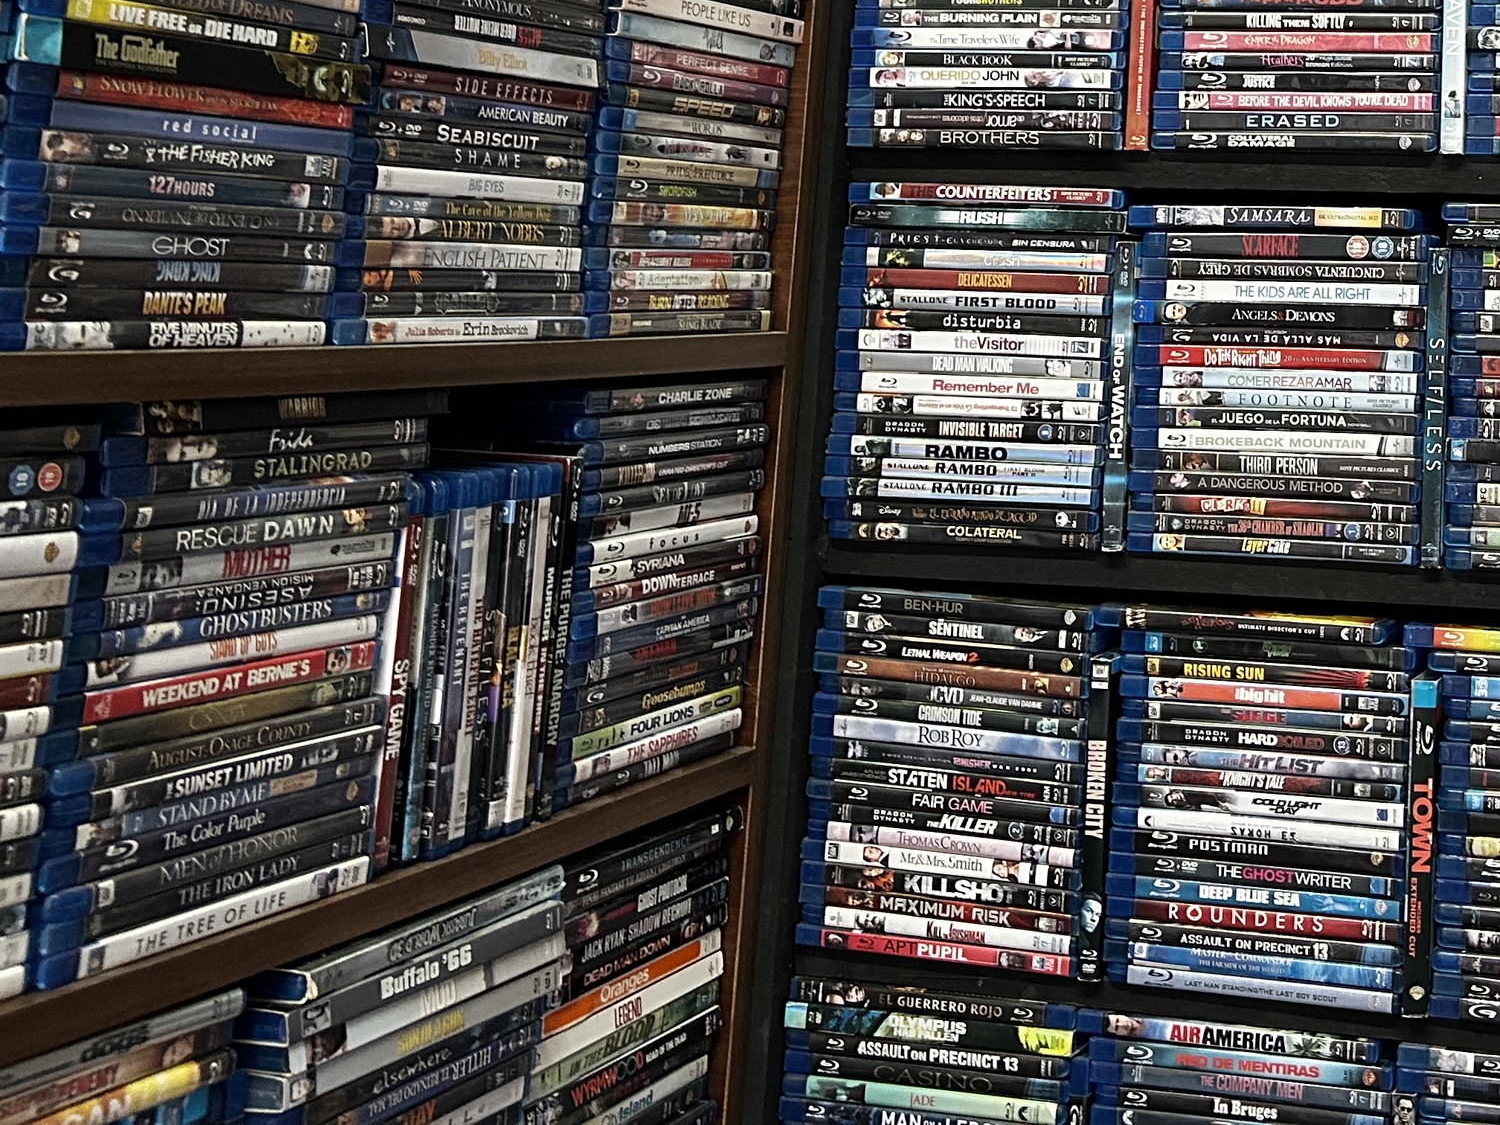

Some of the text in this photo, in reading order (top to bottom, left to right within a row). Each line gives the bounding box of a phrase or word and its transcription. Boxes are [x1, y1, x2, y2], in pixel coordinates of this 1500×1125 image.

[681, 0, 751, 27] PEOPLE LIKE US
[943, 53, 1012, 66] BLACK BOOK
[455, 76, 553, 104] SIDE EFFECTS
[477, 105, 569, 128] AMERICAN BEAUTY
[672, 98, 735, 119] SPEED
[163, 118, 257, 141] red social
[1246, 115, 1340, 127] ERASED
[437, 124, 539, 151] SEABISCUIT
[940, 131, 1040, 144] BROTHERS
[454, 148, 521, 169] SHAME
[958, 211, 1003, 224] RUSH
[152, 236, 230, 257] GHOST
[955, 296, 1057, 309] FIRST BLOOD
[942, 314, 1021, 329] disturbia
[658, 387, 733, 405] CHARLIE ZONE
[932, 379, 1039, 394] Remember Me
[924, 444, 1008, 460] RAMBO
[254, 451, 372, 478] STALINGRAD
[1239, 456, 1318, 475] THIRD PERSON
[176, 516, 334, 551] RESCUE DAWN
[903, 599, 964, 615] BEN-HUR
[199, 599, 332, 637] GHOSTBUSTERS
[142, 660, 311, 704] WEEKEND AT BERNIE'S
[1183, 663, 1265, 680] RISING SUN
[629, 705, 694, 735] FOUR LIONS
[912, 793, 993, 814] FAIR GAME
[136, 892, 287, 954] THE TREE OF LIFE
[1167, 904, 1324, 933] ROUNDERS
[380, 954, 439, 1000] Buffalo
[613, 998, 643, 1029] LEGEND
[1213, 1097, 1278, 1121] In Bruges
